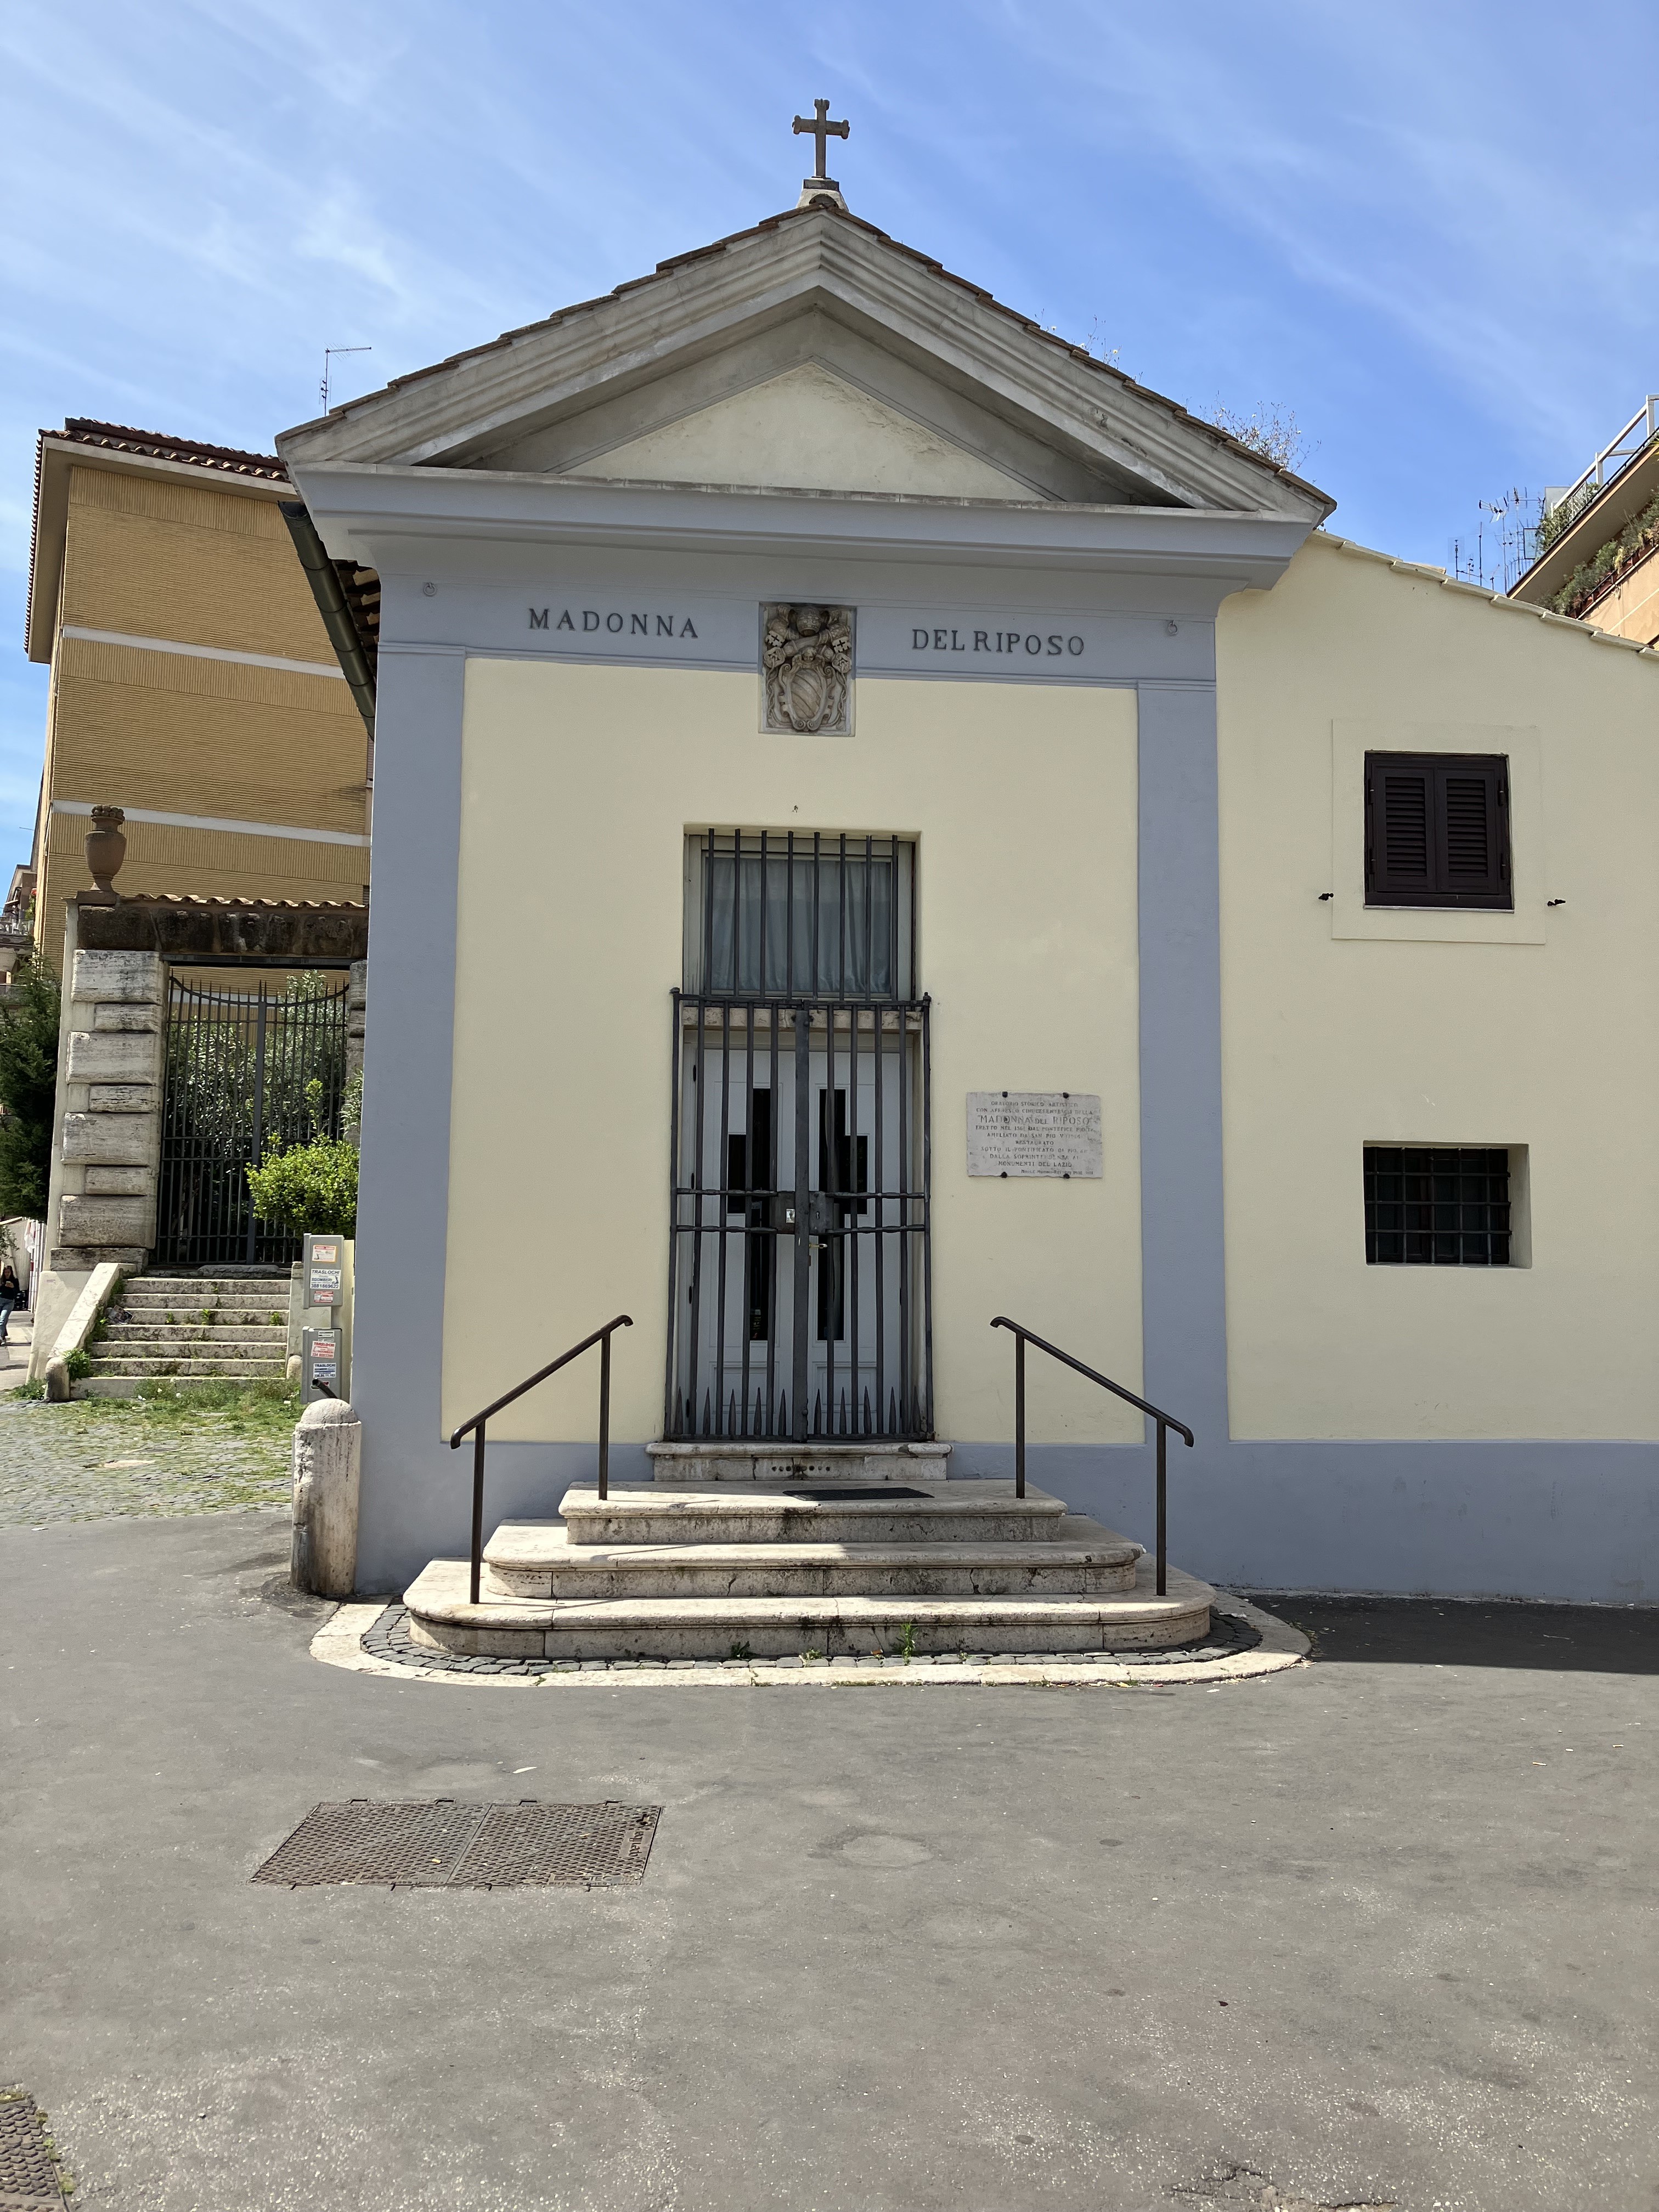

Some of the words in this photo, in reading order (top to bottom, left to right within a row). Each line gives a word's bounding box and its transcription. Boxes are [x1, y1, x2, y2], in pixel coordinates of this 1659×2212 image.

[529, 608, 698, 638] MADONNA
[912, 629, 965, 651] DEL
[973, 631, 1084, 656] RIPOSO
